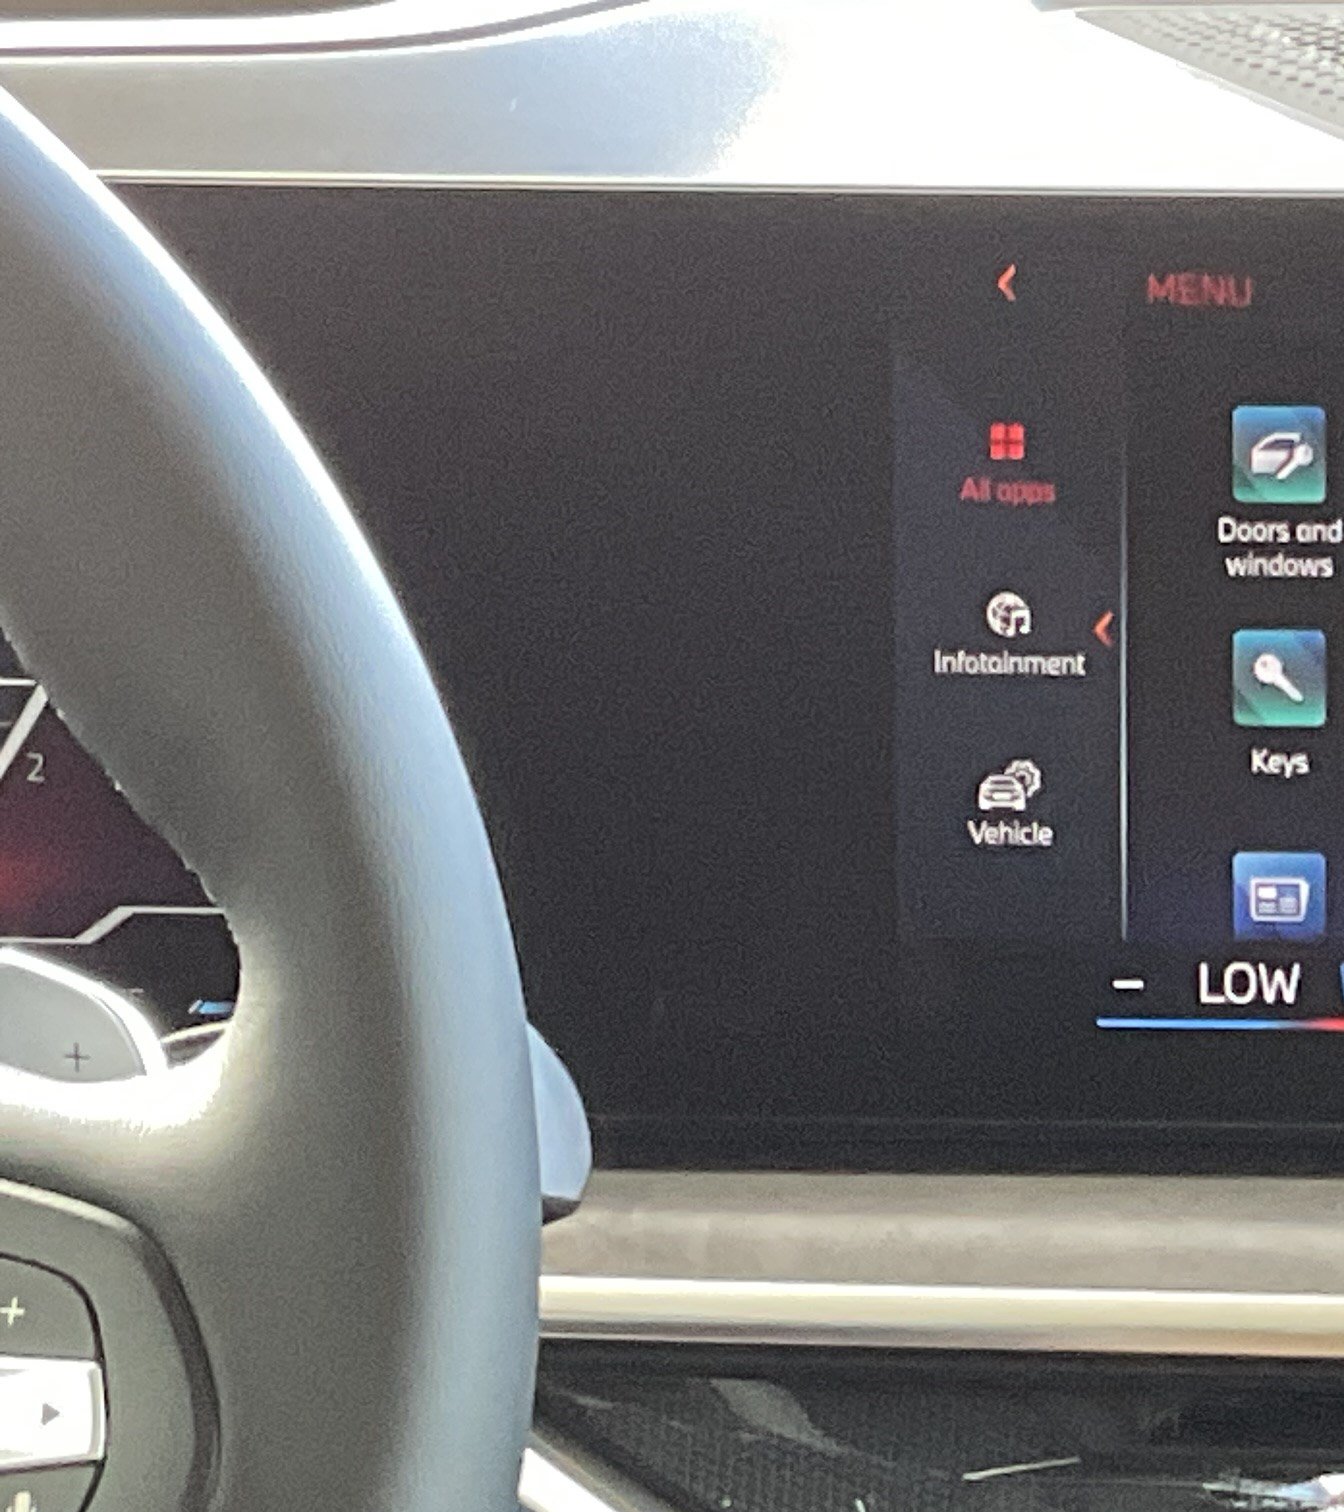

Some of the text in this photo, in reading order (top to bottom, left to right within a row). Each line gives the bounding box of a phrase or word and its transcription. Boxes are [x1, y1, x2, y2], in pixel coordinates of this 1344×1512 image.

[1147, 273, 1252, 308] MENU
[959, 477, 1056, 506] All apps
[1217, 516, 1343, 543] Doors and
[1225, 552, 1334, 578] windows
[933, 650, 1086, 678] Infotainment
[26, 752, 45, 782] 2
[1250, 748, 1310, 778] Keys
[967, 819, 1054, 847] Vehicle
[1198, 961, 1302, 1005] LOW
